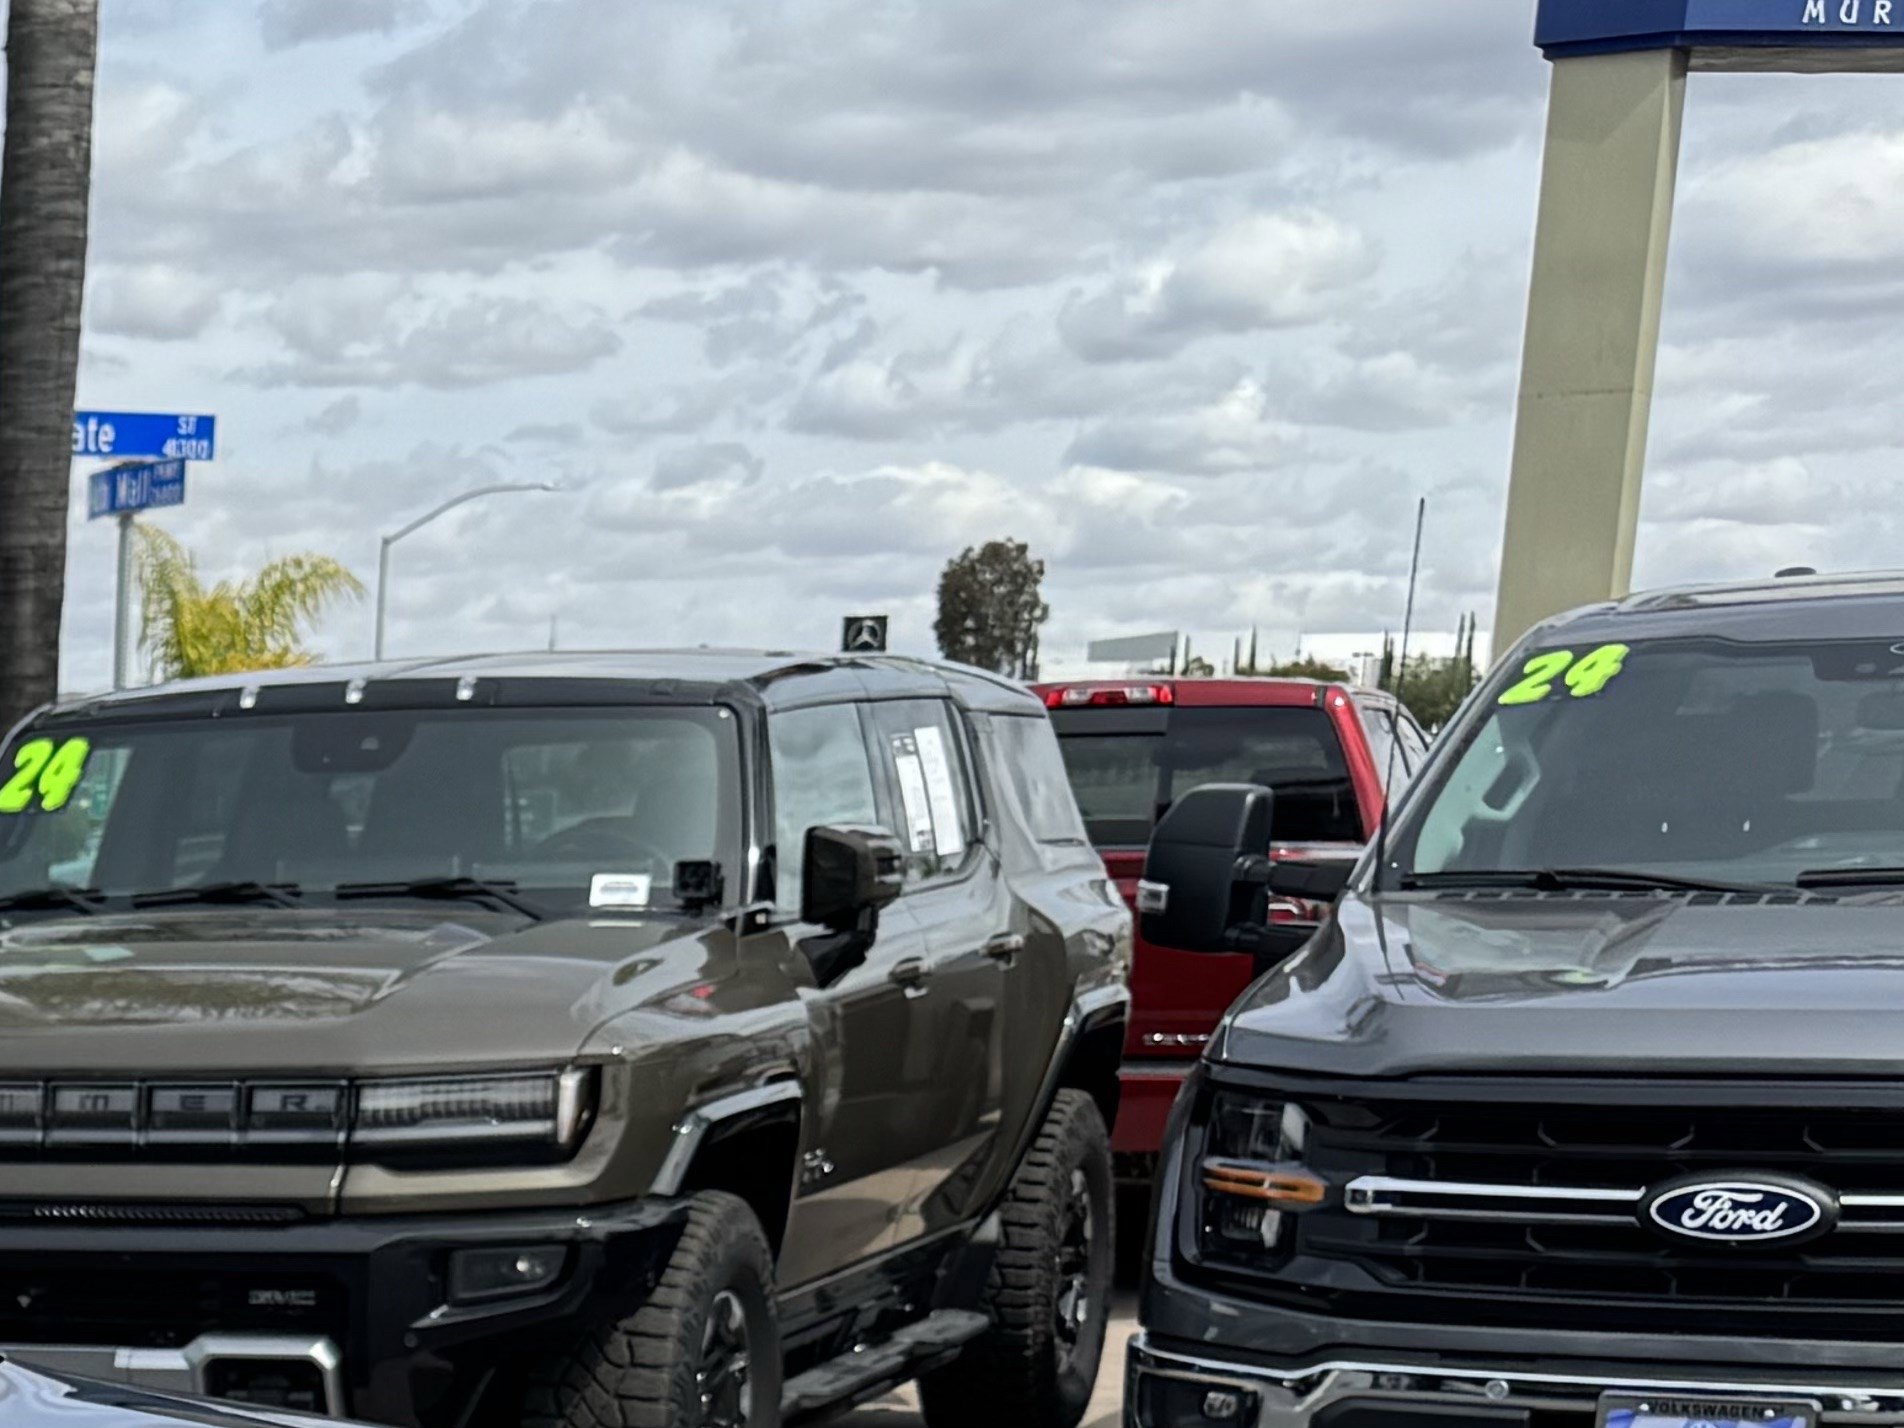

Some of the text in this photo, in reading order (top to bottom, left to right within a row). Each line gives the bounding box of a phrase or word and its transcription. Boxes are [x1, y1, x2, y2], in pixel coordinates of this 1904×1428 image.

[1497, 643, 1630, 705] 24
[1681, 1190, 1788, 1231] Ford
[1648, 1401, 1765, 1419] VOLKSWAGEN
